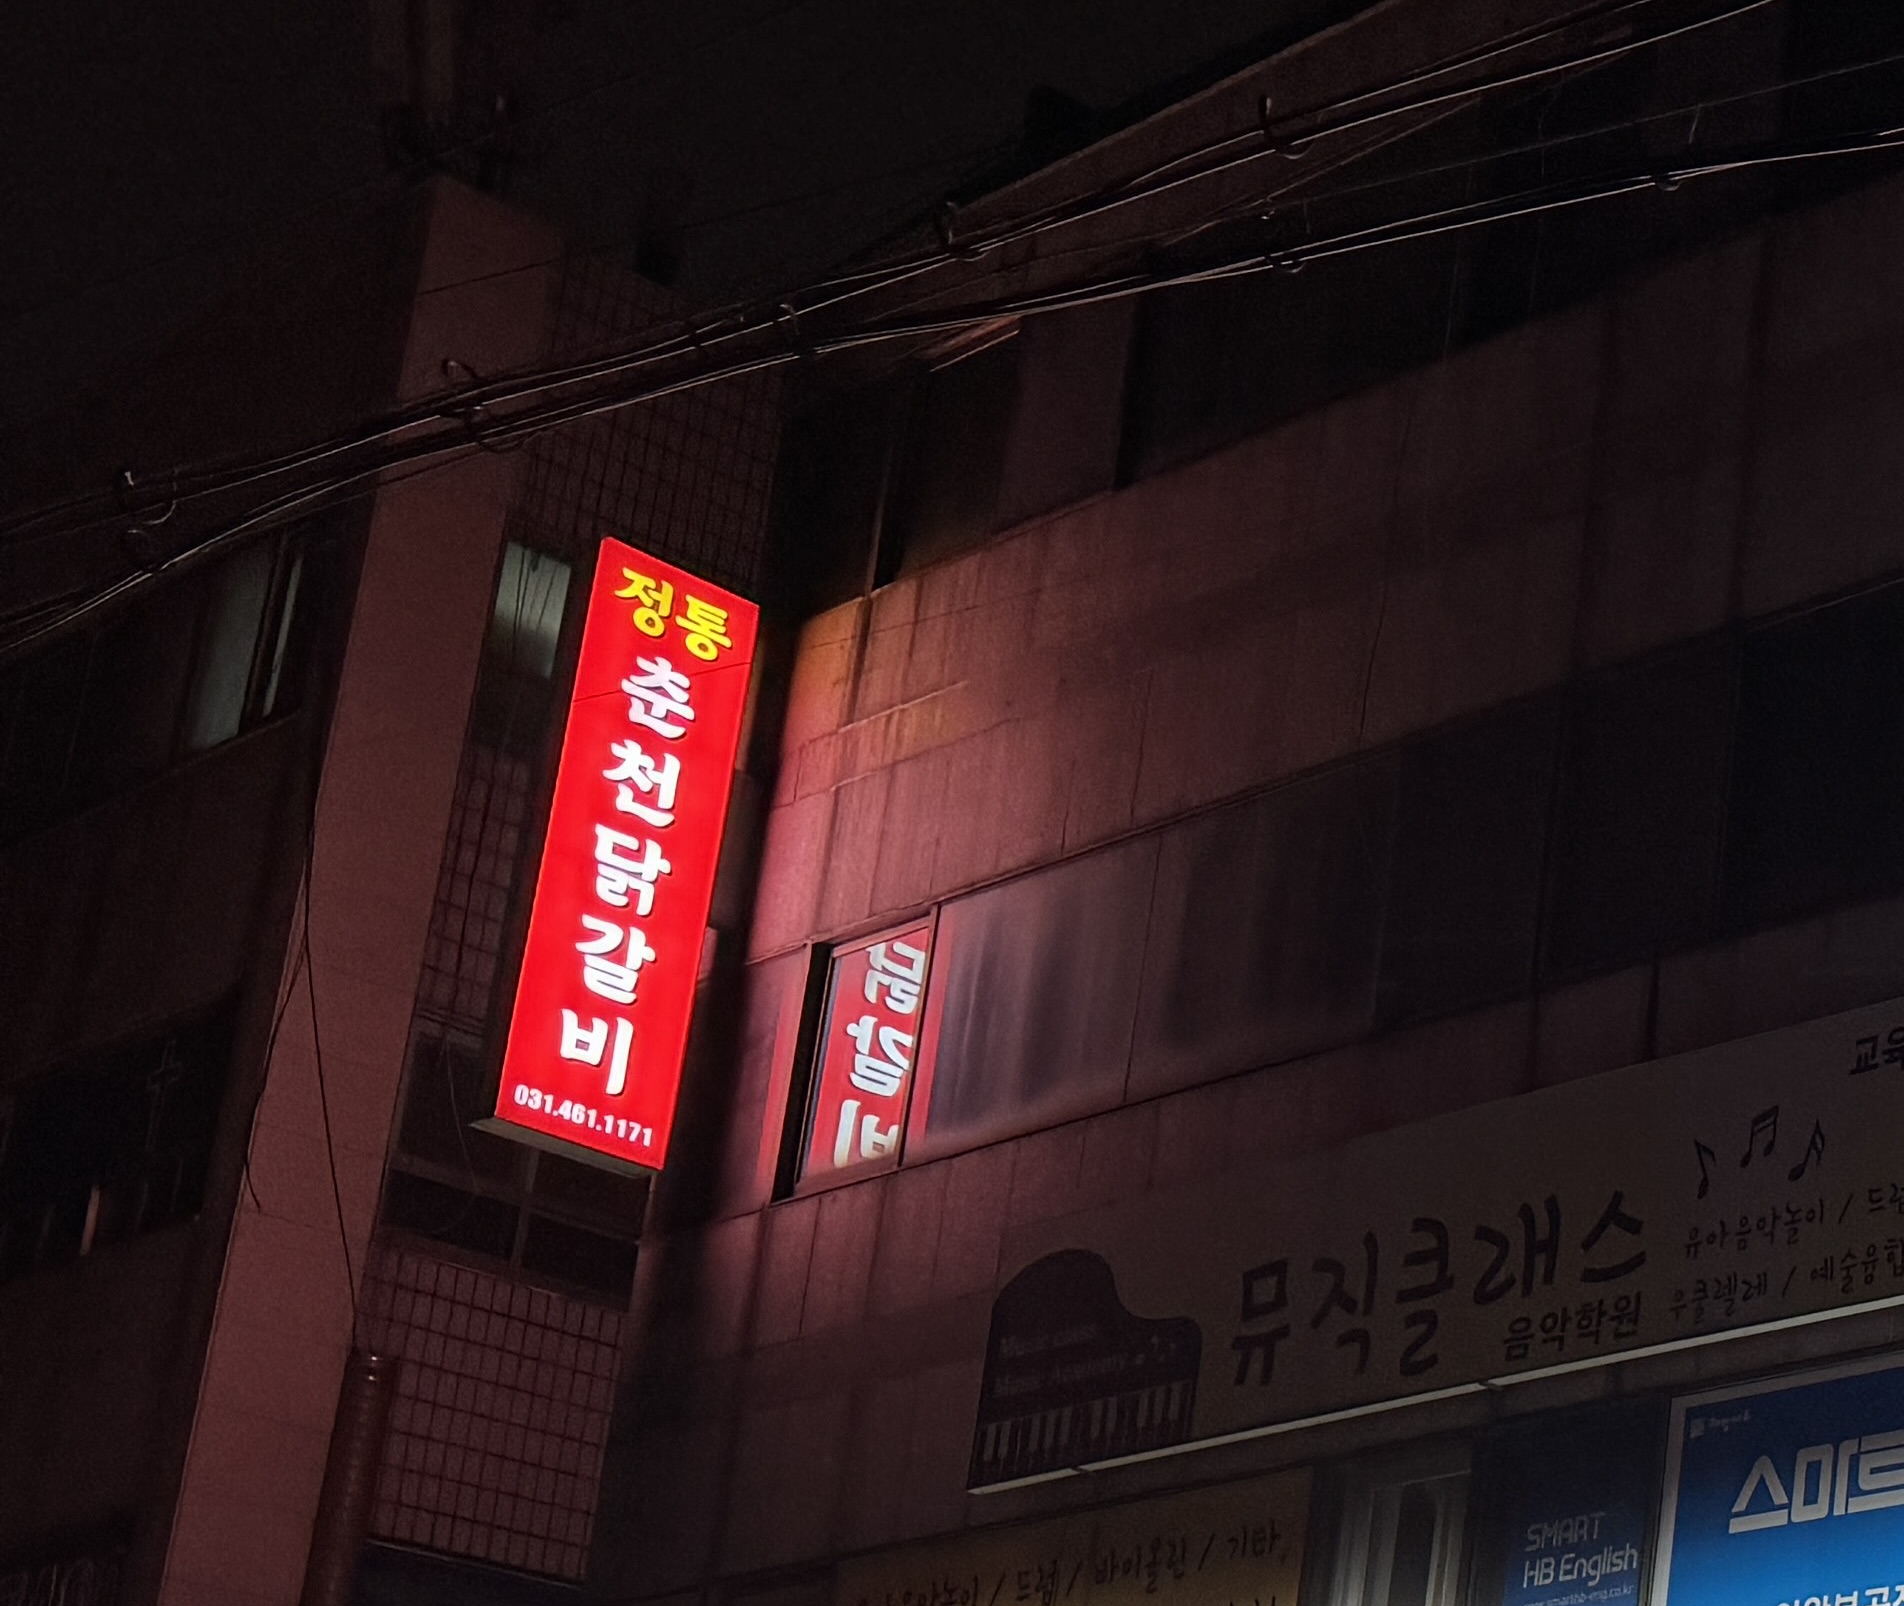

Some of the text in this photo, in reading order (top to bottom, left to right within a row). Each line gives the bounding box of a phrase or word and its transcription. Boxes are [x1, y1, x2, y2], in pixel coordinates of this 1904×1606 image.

[614, 567, 732, 662] 정통
[560, 655, 695, 1097] 춘천닭갈비
[513, 1083, 652, 1148] 031.461.1171
[1684, 1203, 1825, 1260] 유아음악놀이
[1231, 1190, 1647, 1387] 뮤직클래스
[1669, 1267, 1768, 1324] 우쿨렐레
[1503, 1291, 1642, 1362] 음악학원
[1523, 1542, 1638, 1588] HB English
[1525, 1511, 1606, 1552] SMART
[1016, 1560, 1059, 1606] 드럼
[1095, 1537, 1187, 1594] 바이올린
